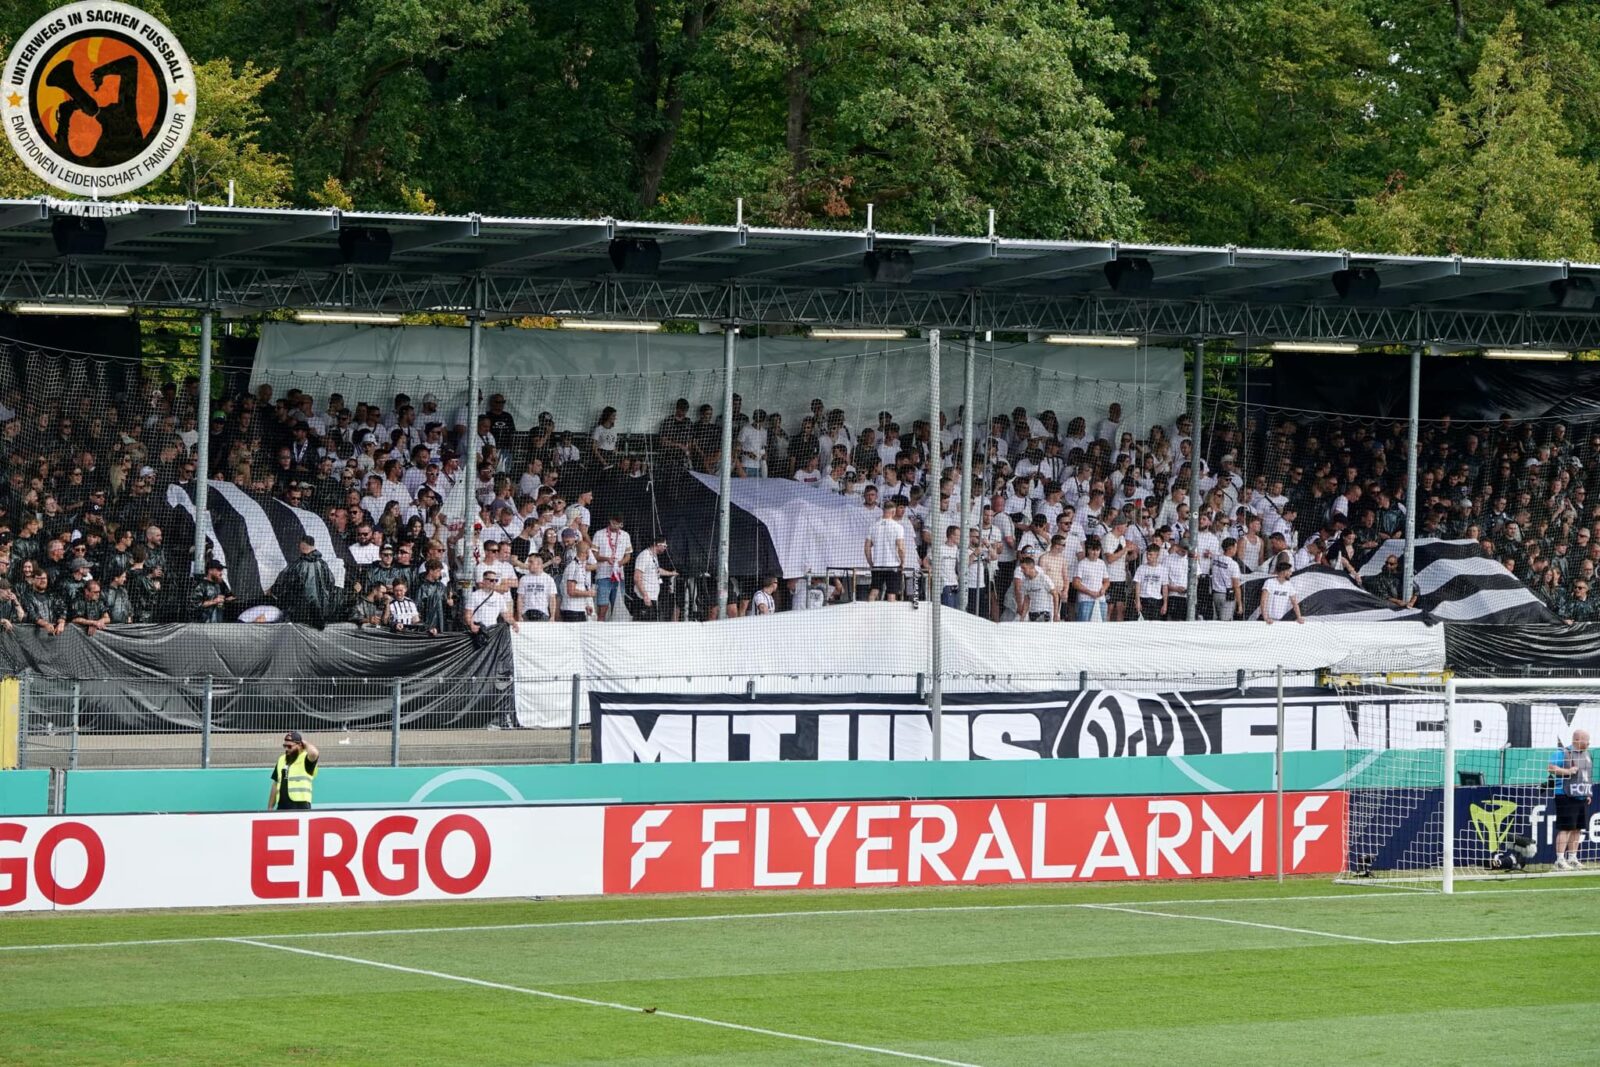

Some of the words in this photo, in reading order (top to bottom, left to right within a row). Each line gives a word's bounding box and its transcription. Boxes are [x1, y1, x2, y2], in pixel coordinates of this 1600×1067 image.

[601, 713, 797, 763] MIT
[250, 813, 492, 900] ERGO
[701, 798, 1264, 889] FLYERALARM
